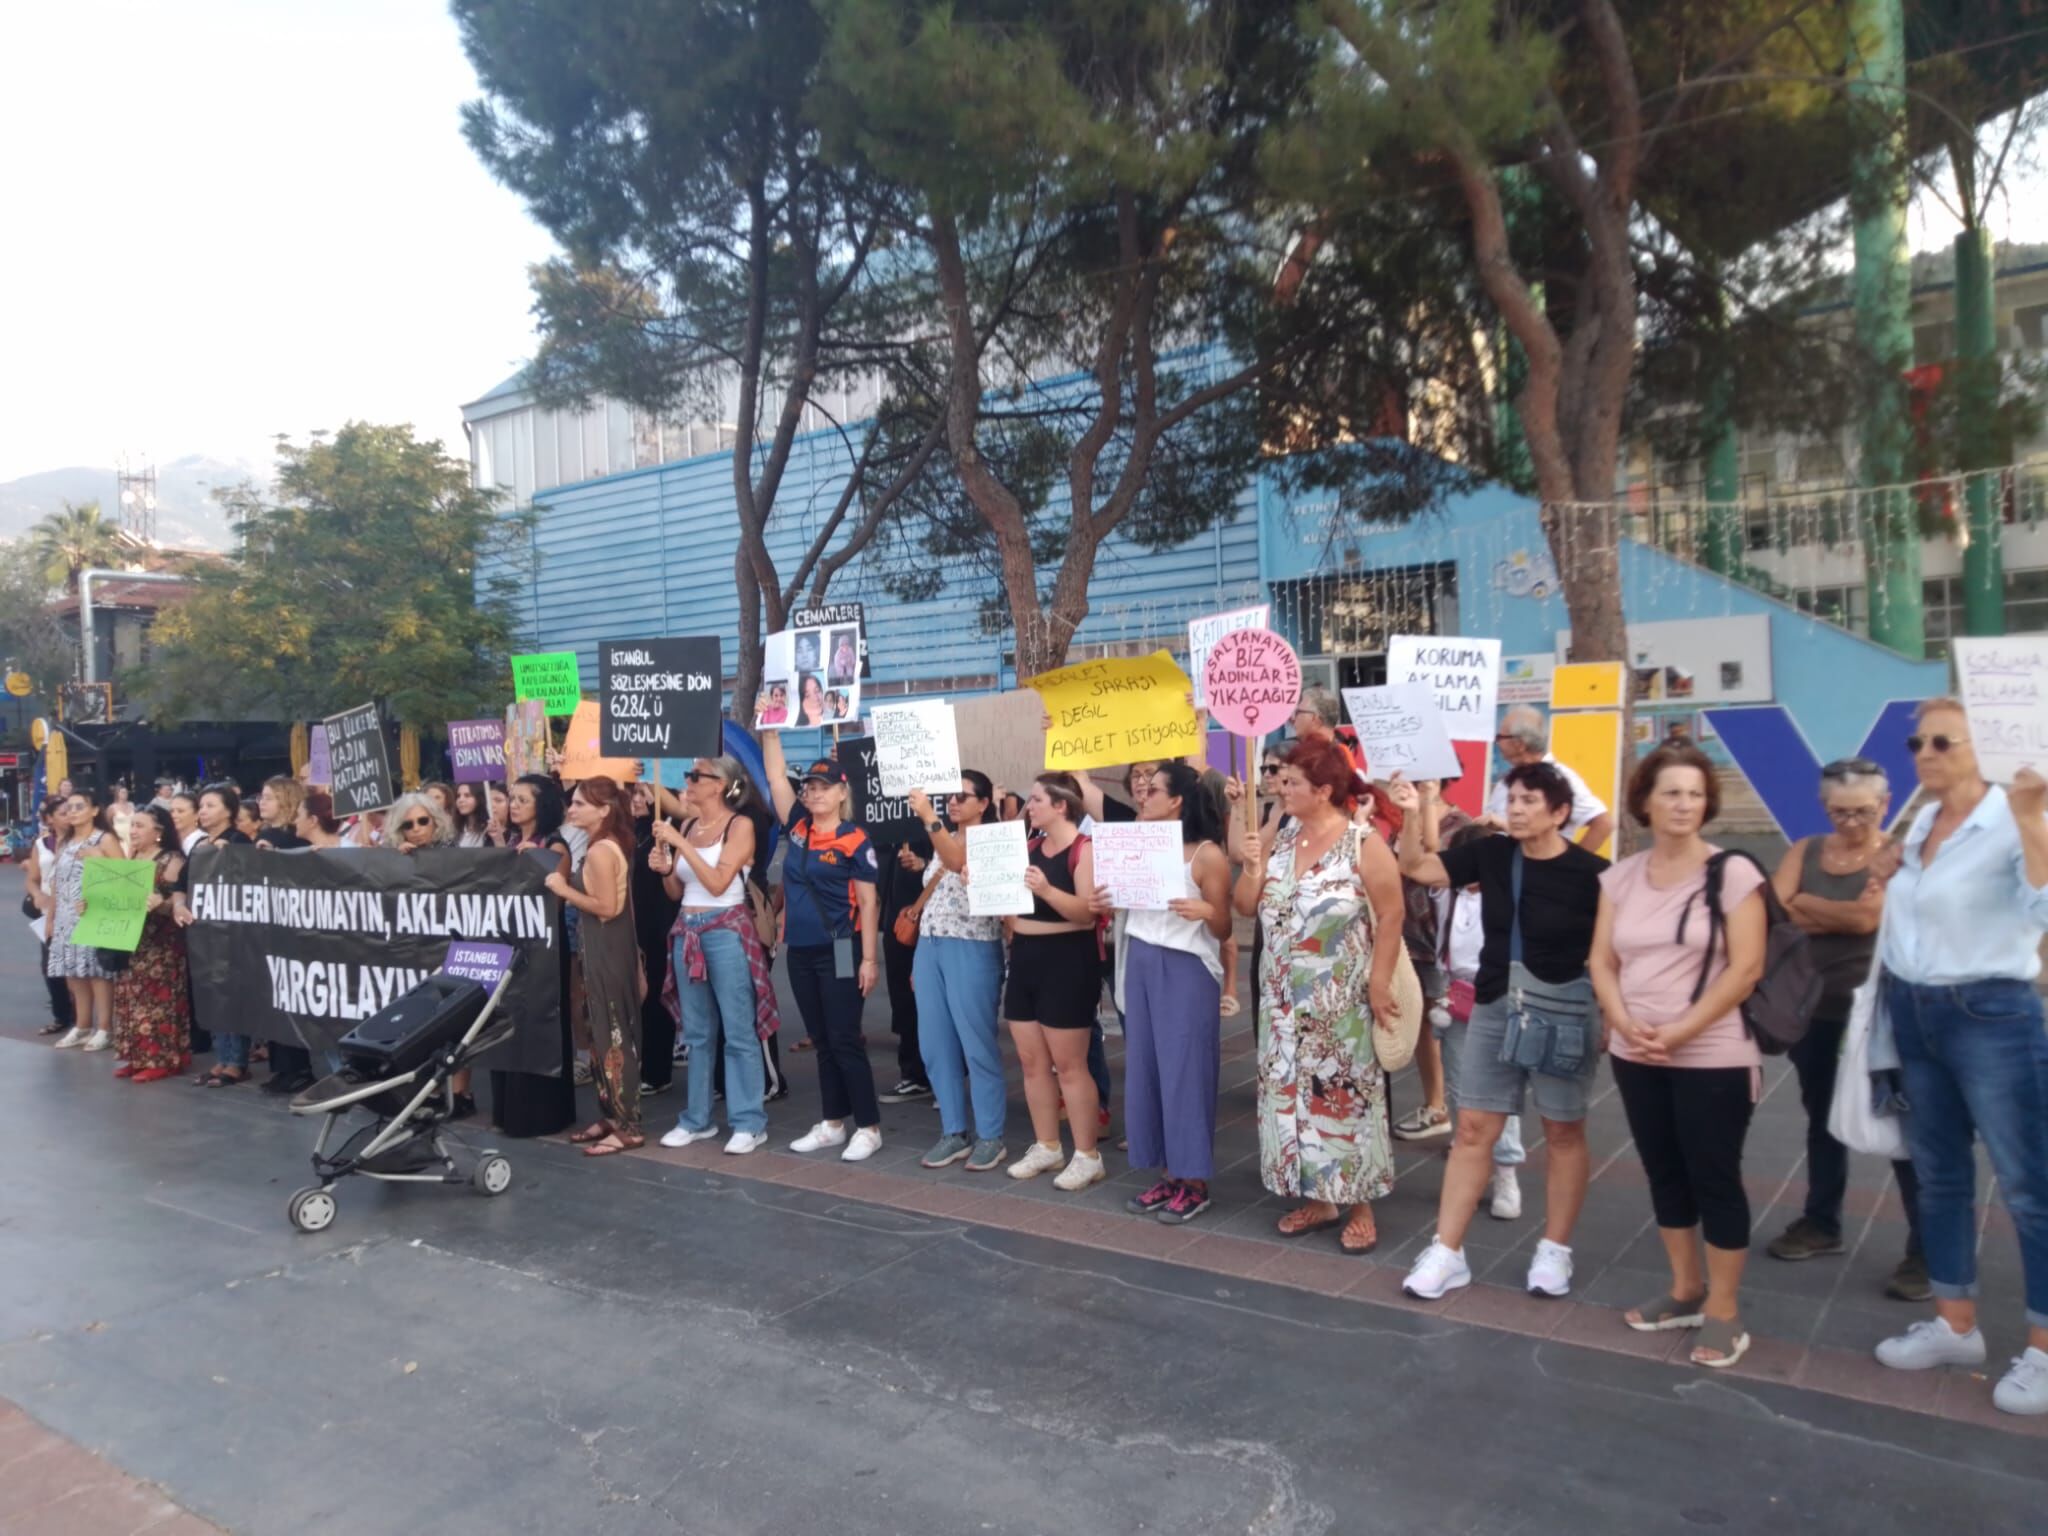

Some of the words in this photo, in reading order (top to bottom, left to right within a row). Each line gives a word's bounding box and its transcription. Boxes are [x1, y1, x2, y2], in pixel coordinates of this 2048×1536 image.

[795, 604, 861, 627] CEMAATLERE
[611, 648, 655, 667] İSTANBUL
[1207, 631, 1299, 687] SALTANATINIZI
[1236, 644, 1266, 668] BİZ
[1415, 648, 1487, 667] KORUMA
[610, 671, 684, 692] SÖZLEŞMESİNE
[687, 671, 712, 691] DÖN
[1208, 668, 1282, 686] KADINLAR
[1210, 687, 1297, 707] YIKACAĞIZ
[327, 723, 342, 745] BU
[343, 709, 379, 738] ÜLKEDE
[612, 723, 671, 750] UYGULA!
[332, 738, 367, 771] KADIN
[483, 742, 507, 766] VAR
[1051, 733, 1117, 759] ADALET
[350, 781, 381, 809] VAR
[192, 874, 270, 924] FAİLLERİ
[271, 886, 391, 942] KORUMAYIN,
[397, 892, 553, 949] AKLAMAYIN,
[454, 948, 500, 966] İSTANBUL
